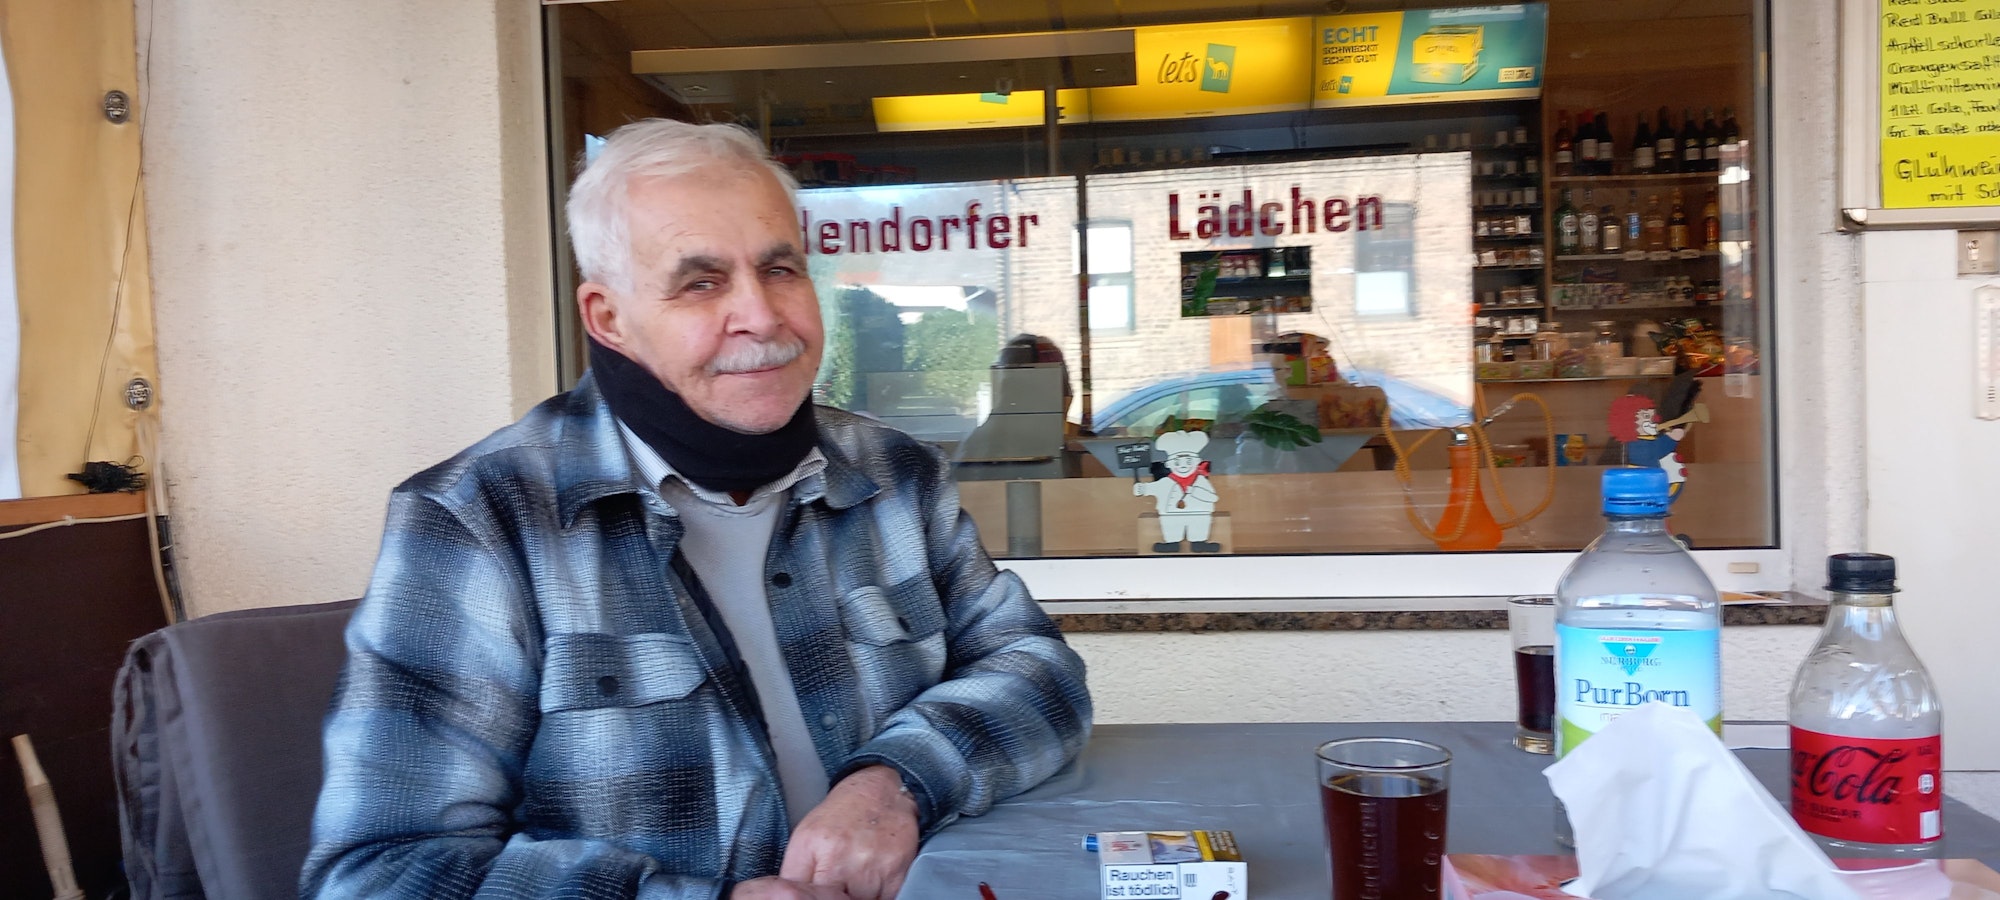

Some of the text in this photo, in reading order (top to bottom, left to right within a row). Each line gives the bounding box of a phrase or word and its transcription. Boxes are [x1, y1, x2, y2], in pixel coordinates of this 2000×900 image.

[1882, 12, 1922, 27] Red
[1925, 11, 1970, 25] Bull
[1323, 26, 1379, 44] ECHT
[1322, 54, 1379, 65] ECHT GUT
[1928, 184, 1966, 201] mit
[1168, 187, 1384, 241] Lädchen
[1574, 678, 1692, 707] PurBorn
[1110, 869, 1174, 881] Rauchen
[1106, 883, 1179, 897] ist tödlich
